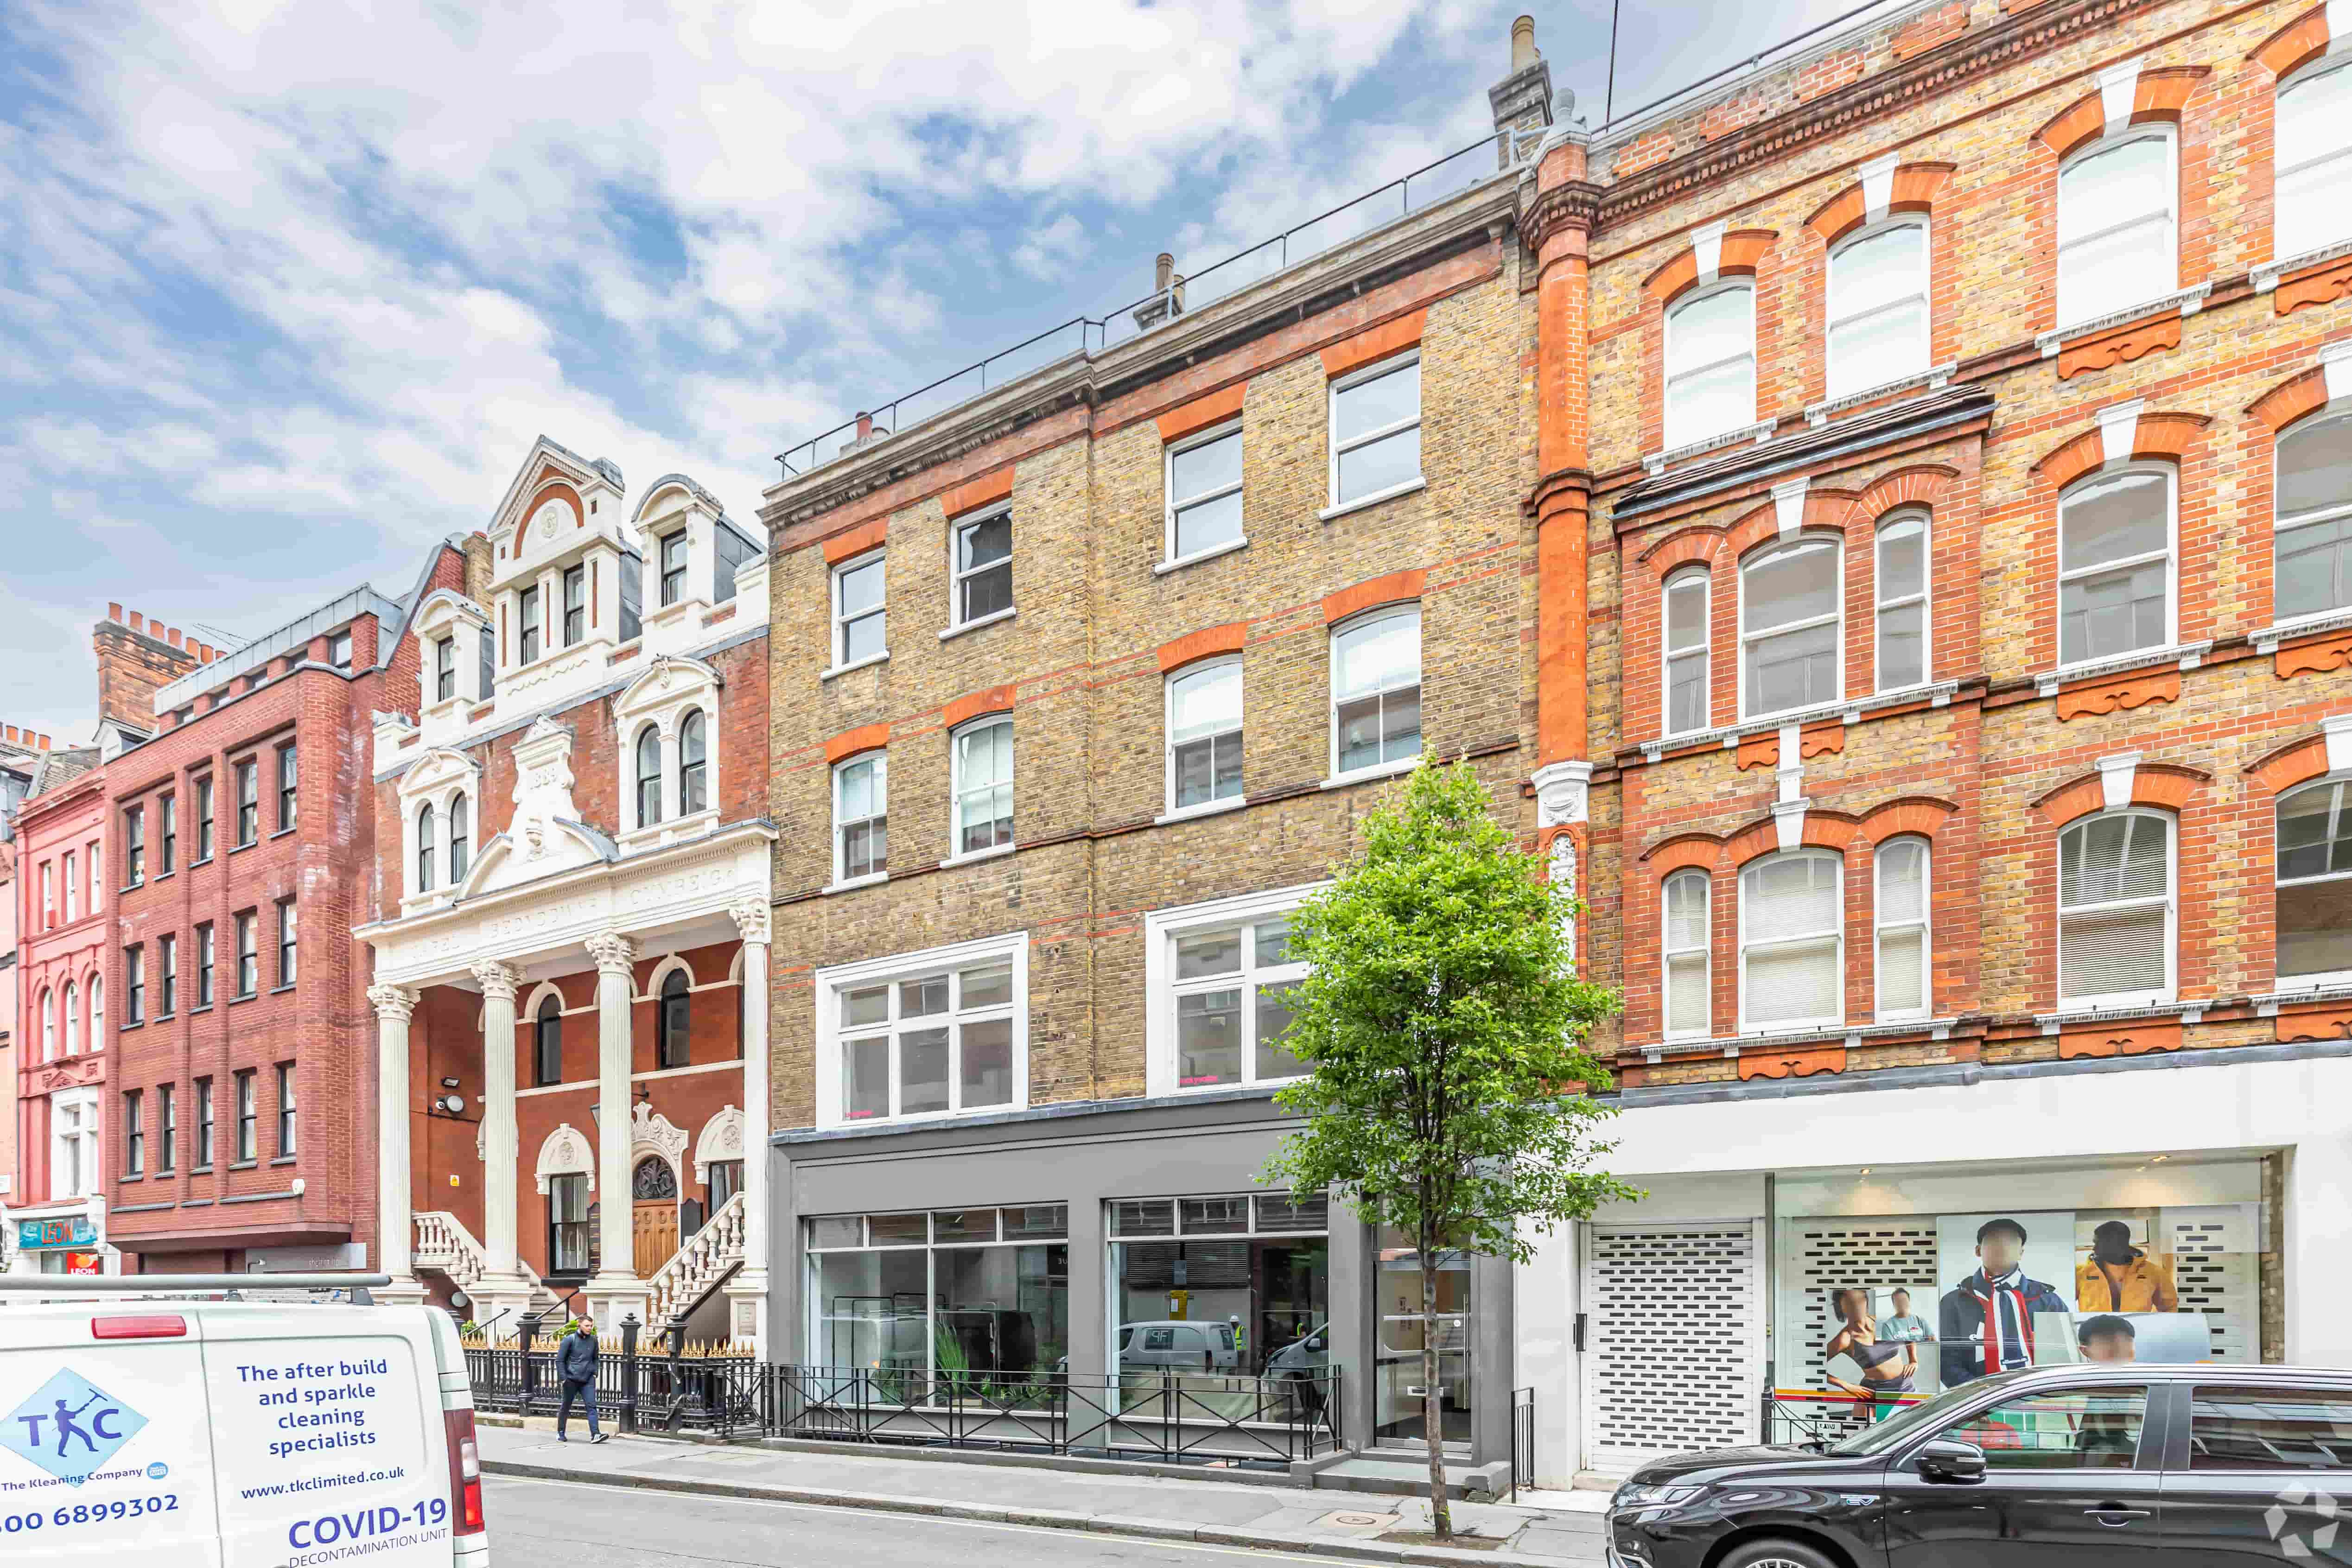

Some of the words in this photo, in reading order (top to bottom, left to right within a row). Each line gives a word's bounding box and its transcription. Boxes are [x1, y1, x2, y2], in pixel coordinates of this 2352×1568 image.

[42, 1219, 74, 1244] LEON
[237, 1365, 278, 1382] The
[286, 1363, 334, 1379] after
[340, 1359, 387, 1376] build
[260, 1388, 297, 1405] and
[305, 1383, 375, 1405] sparkle
[279, 1409, 364, 1428] cleaning
[269, 1431, 376, 1458] specialists
[2, 1481, 26, 1491] The
[30, 1474, 85, 1488] Kleaning
[88, 1468, 142, 1480] Company
[241, 1467, 404, 1499] www.tkclimited.co.uk
[0, 1512, 43, 1532] 00
[53, 1494, 178, 1526] 6899302
[289, 1498, 446, 1548] COVID-19
[290, 1535, 417, 1568] DECONTAMINATION
[421, 1528, 448, 1543] UNIT
